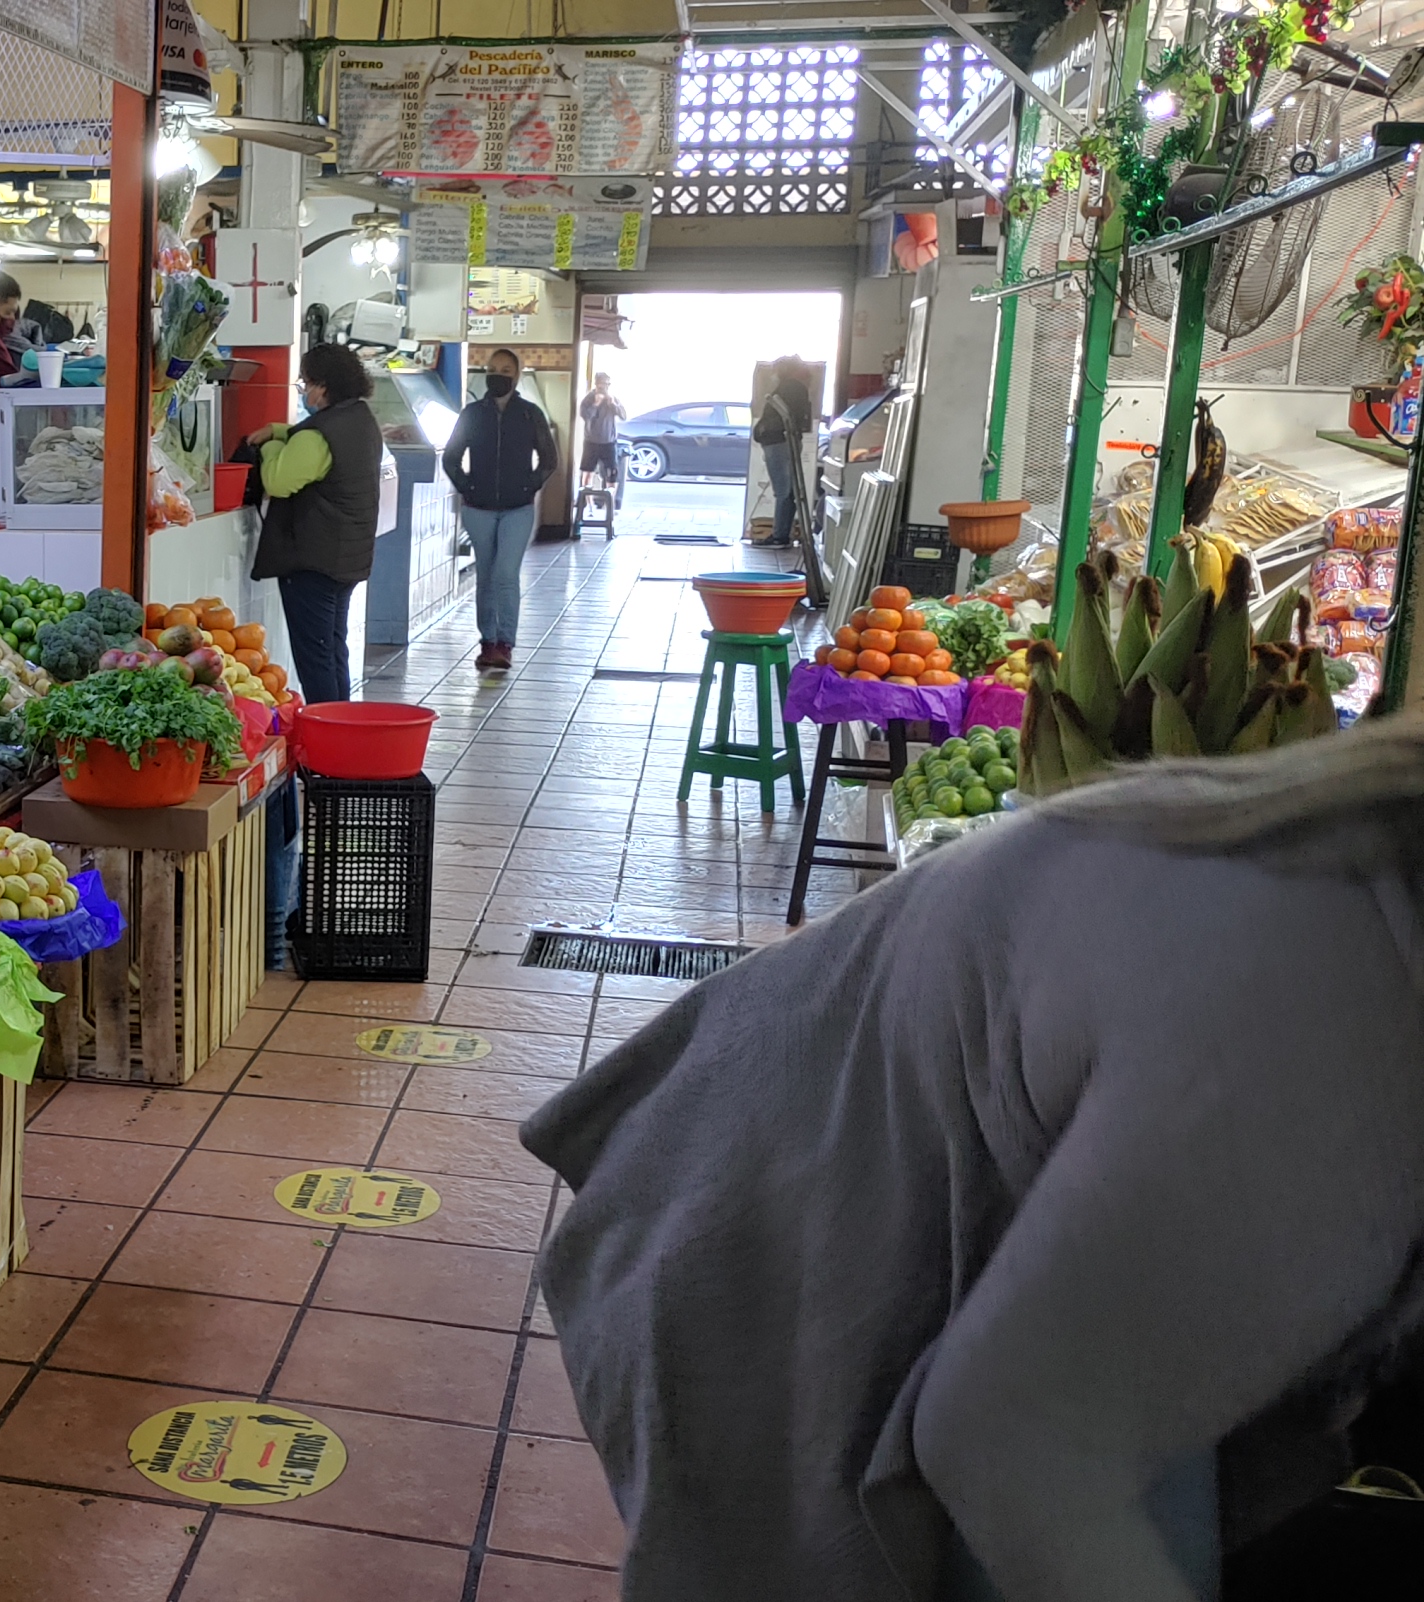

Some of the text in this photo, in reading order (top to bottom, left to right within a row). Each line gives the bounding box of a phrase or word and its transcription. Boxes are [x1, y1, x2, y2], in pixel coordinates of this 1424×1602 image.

[469, 50, 543, 61] Pescadería
[584, 50, 636, 59] MARISCO
[340, 61, 384, 69] ENTERO
[460, 64, 550, 75] del Pacífico
[404, 72, 420, 80] 100
[402, 102, 419, 110] 100
[487, 102, 506, 111] 120
[558, 103, 578, 111] 220
[487, 112, 505, 121] 120
[560, 113, 577, 121] 120
[485, 122, 505, 131] 320
[558, 123, 575, 132] 120
[485, 132, 503, 141] 200
[557, 133, 575, 142] 200
[485, 142, 503, 151] 120
[397, 152, 413, 160] 100
[484, 152, 502, 161] 200
[555, 153, 574, 162] 320
[483, 163, 502, 171] 250
[158, 1411, 196, 1451] DISTANCIA
[283, 1432, 328, 1471] METROS
[147, 1451, 176, 1473] SANA
